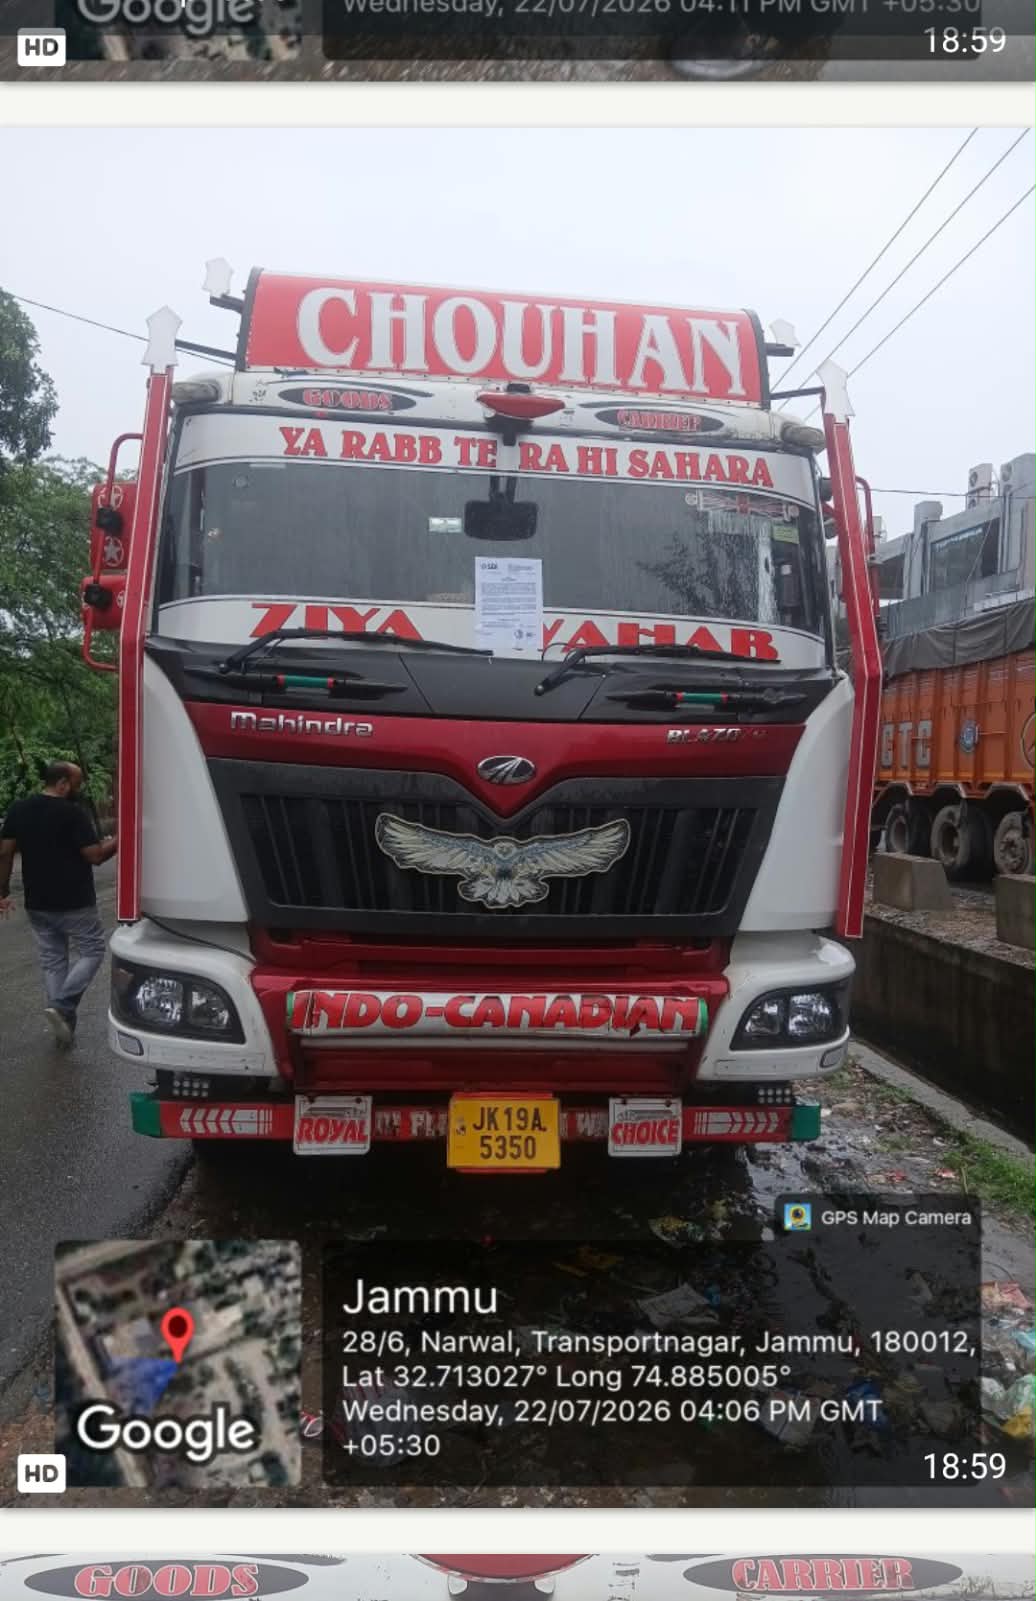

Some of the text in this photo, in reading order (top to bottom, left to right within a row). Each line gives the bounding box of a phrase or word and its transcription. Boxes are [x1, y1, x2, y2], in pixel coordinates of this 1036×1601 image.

[296, 286, 747, 396] CHOUHAN
[280, 427, 774, 489] YA RABB TE RA HI SAHARA
[250, 603, 424, 642] ZIYA
[230, 711, 373, 737] Mahindra
[290, 991, 700, 1032] INDO-CANADIAN
[296, 1116, 368, 1145] ROYAL
[472, 1107, 543, 1132] JK19A
[611, 1117, 680, 1145] CHOICE
[480, 1136, 537, 1160] 5350
[74, 1564, 259, 1597] GOODS
[731, 1558, 915, 1591] CARRIER
